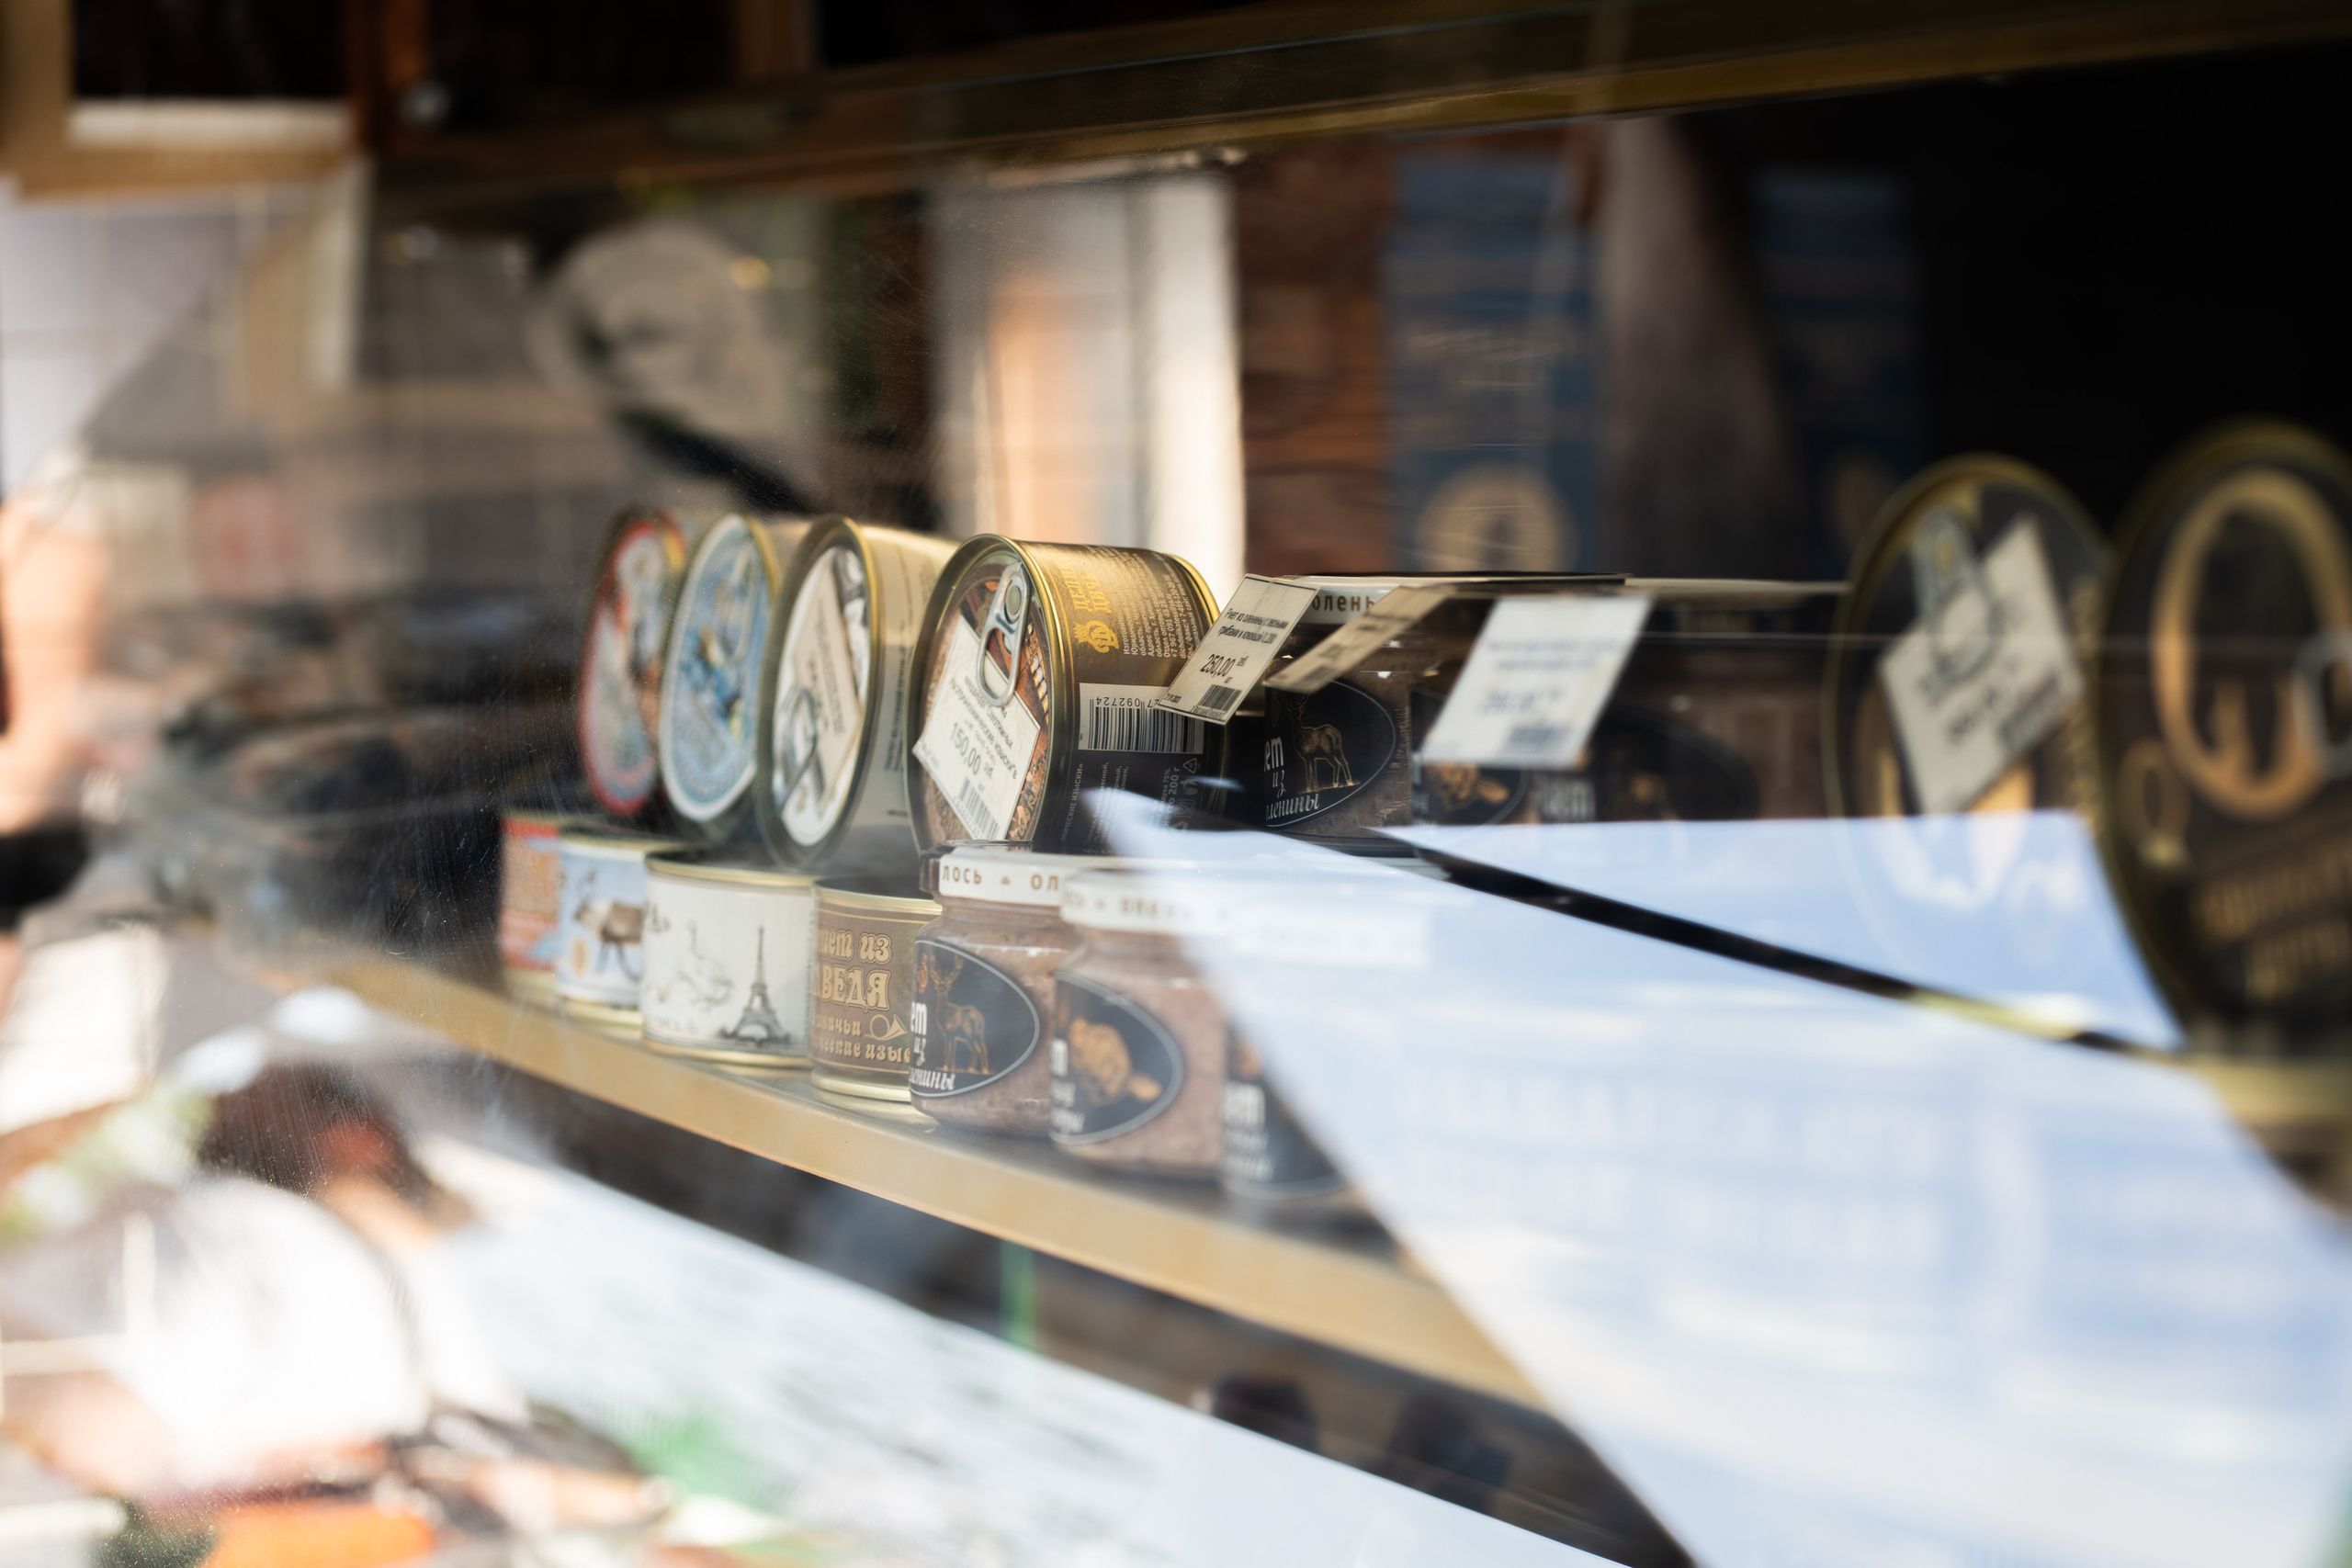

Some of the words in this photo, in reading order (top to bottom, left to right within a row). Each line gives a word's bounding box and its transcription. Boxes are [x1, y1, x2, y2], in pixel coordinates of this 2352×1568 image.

[1164, 619, 1174, 631] 091
[1168, 632, 1177, 647] 967
[1170, 649, 1179, 658] +7
[1200, 653, 1236, 678] 250,00
[1096, 696, 1140, 707] 092724
[949, 722, 981, 775] 150,00
[1263, 736, 1284, 773] ет
[1071, 763, 1083, 801] ИЗЫСКИ»
[1168, 774, 1180, 796] 200
[1272, 770, 1286, 799] из
[1030, 874, 1058, 892] ол
[859, 931, 891, 964] из
[814, 964, 891, 1013] ВЕДЯ
[913, 1036, 927, 1066] из
